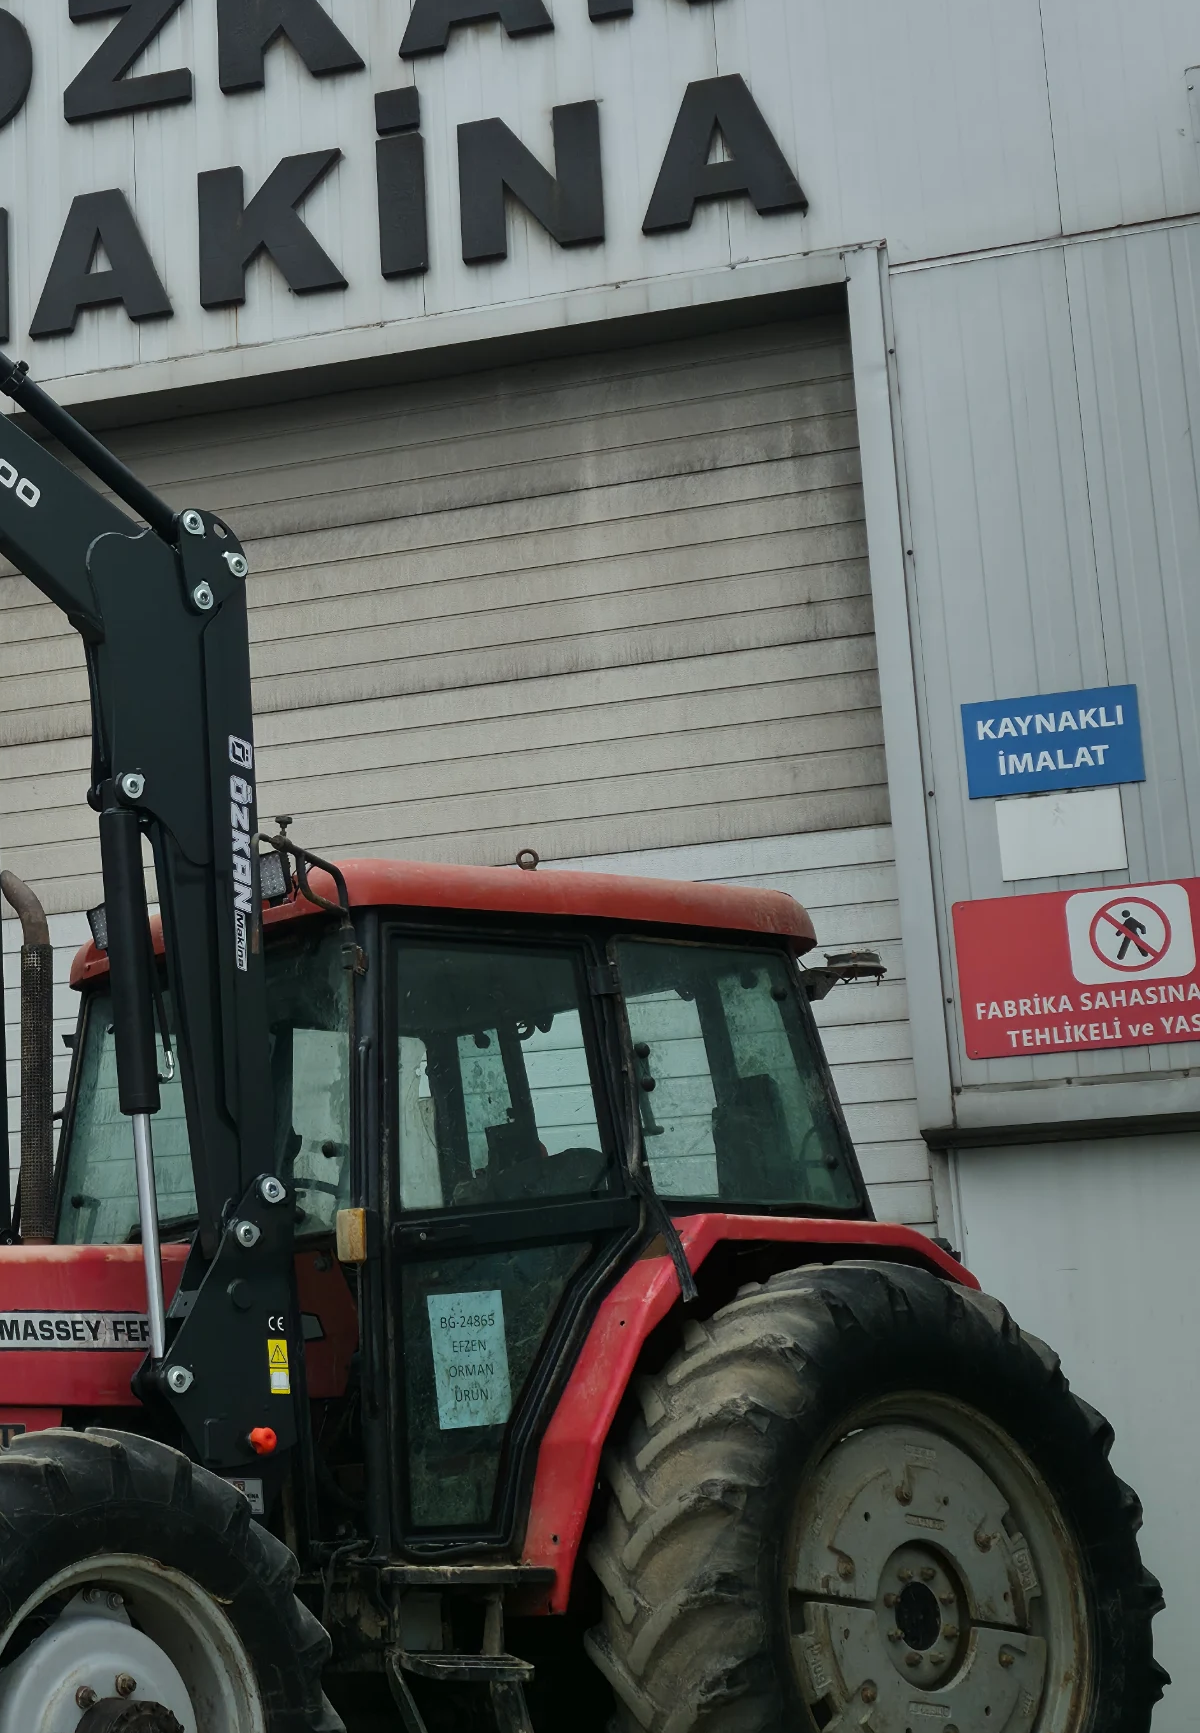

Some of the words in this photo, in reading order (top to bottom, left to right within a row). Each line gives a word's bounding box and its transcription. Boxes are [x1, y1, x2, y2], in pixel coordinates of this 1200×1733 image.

[976, 704, 1124, 741] KAYNAKLI
[998, 744, 1109, 776] İMALAT
[229, 775, 253, 913] ÖZKAN
[975, 993, 1074, 1020] FABRİKA
[1080, 983, 1200, 1011] SAHASINA
[1006, 1017, 1123, 1048] TEHLİKELİ
[1128, 1022, 1154, 1037] ve
[268, 1316, 285, 1331] CE
[449, 1363, 494, 1378] ORMAN
